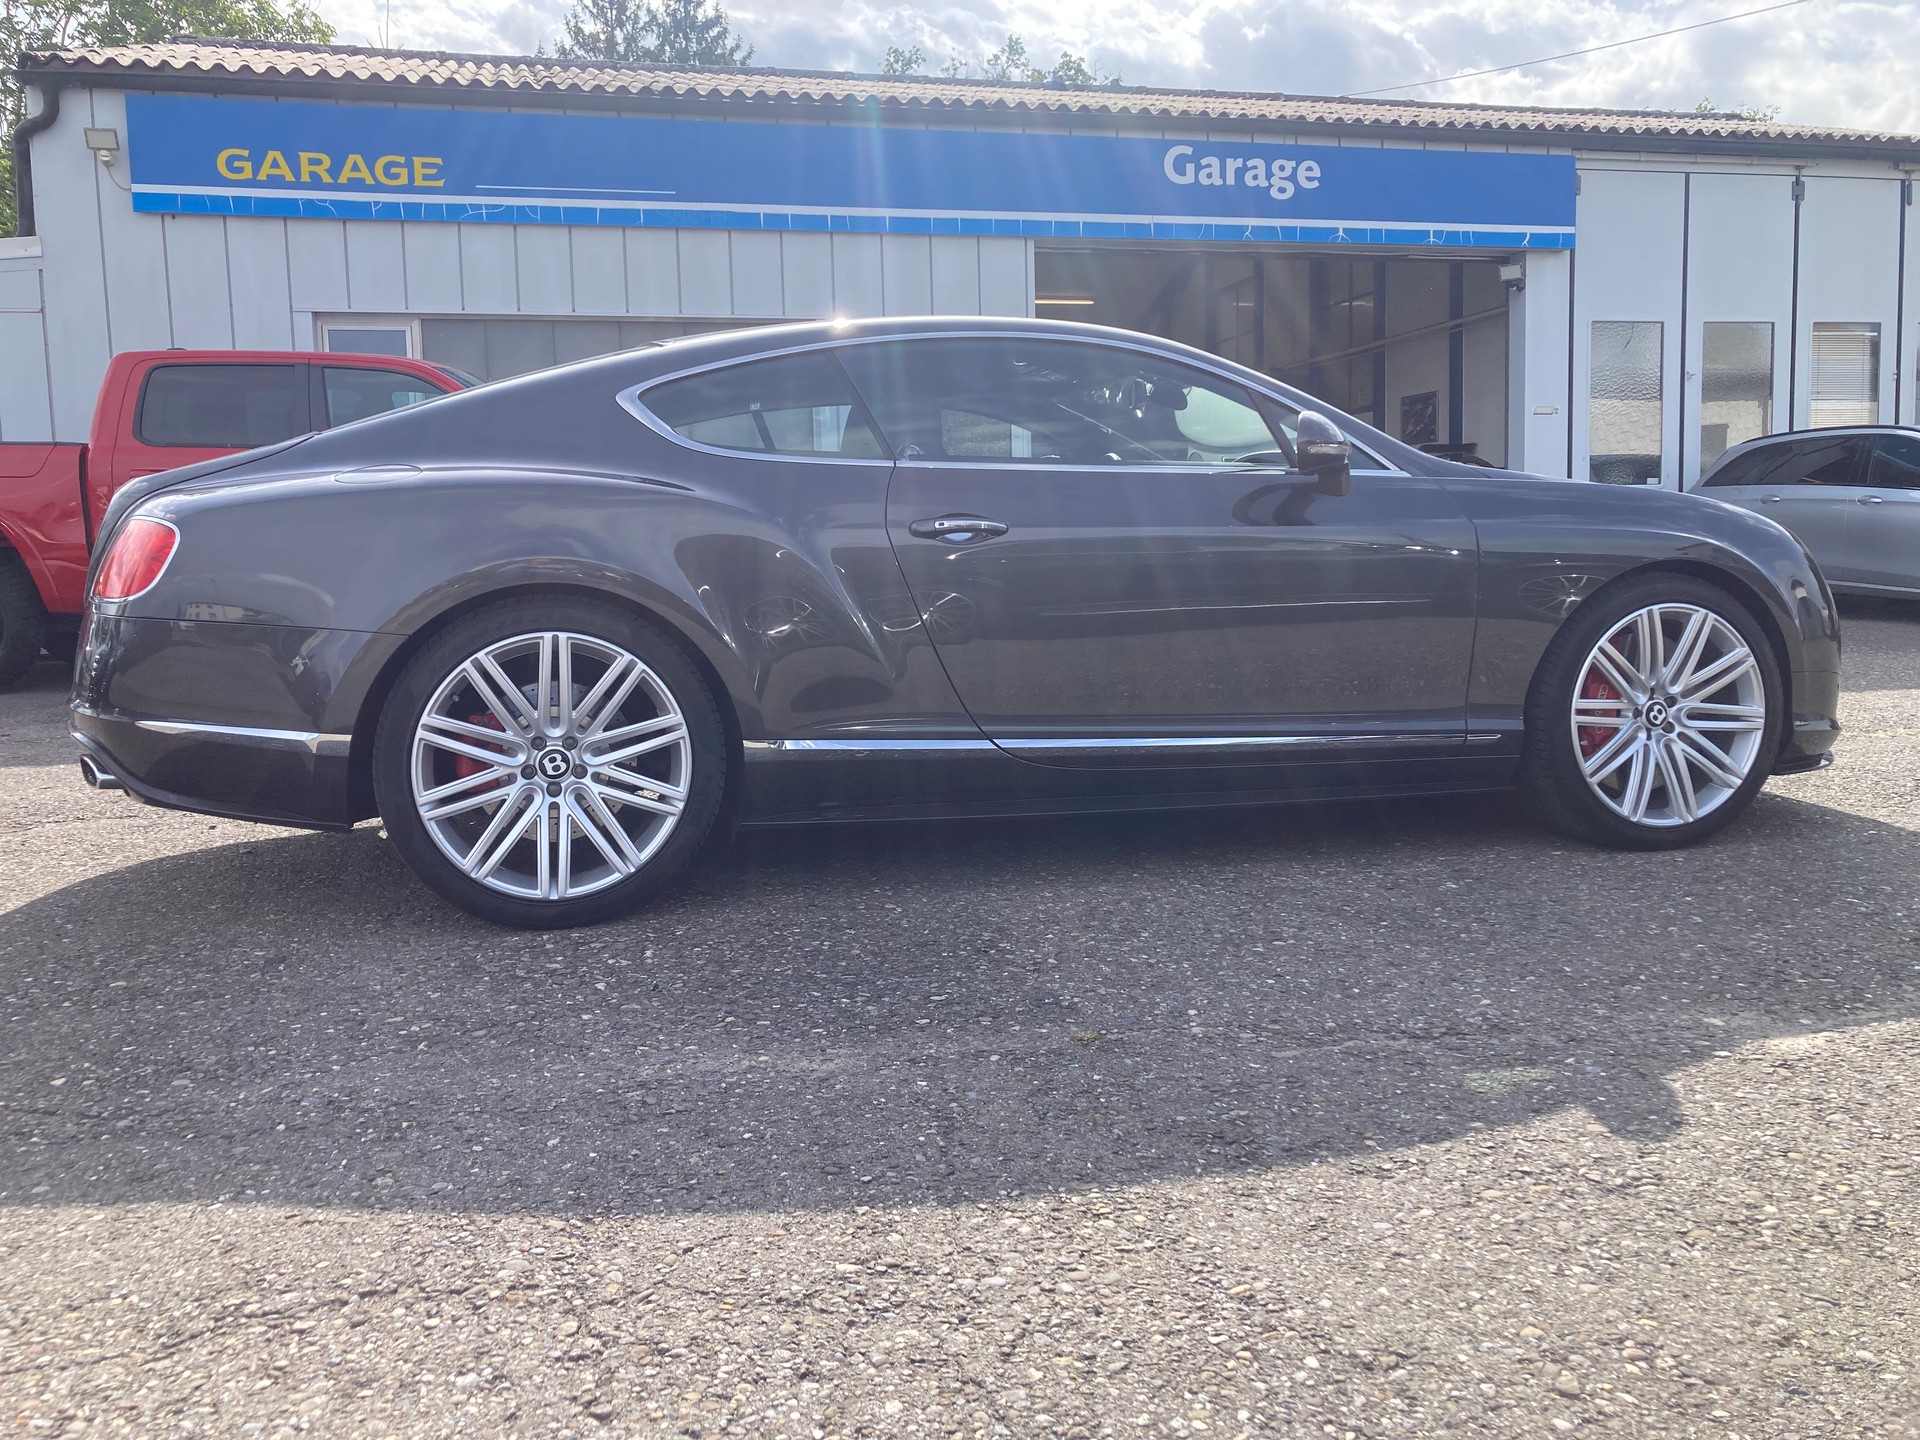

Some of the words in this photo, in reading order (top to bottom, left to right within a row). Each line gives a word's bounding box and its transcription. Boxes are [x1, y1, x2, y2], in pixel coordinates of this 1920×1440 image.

[216, 148, 445, 187] GARAGE
[1163, 145, 1321, 200] Garage
[1649, 704, 1667, 725] B
[542, 753, 567, 775] B
